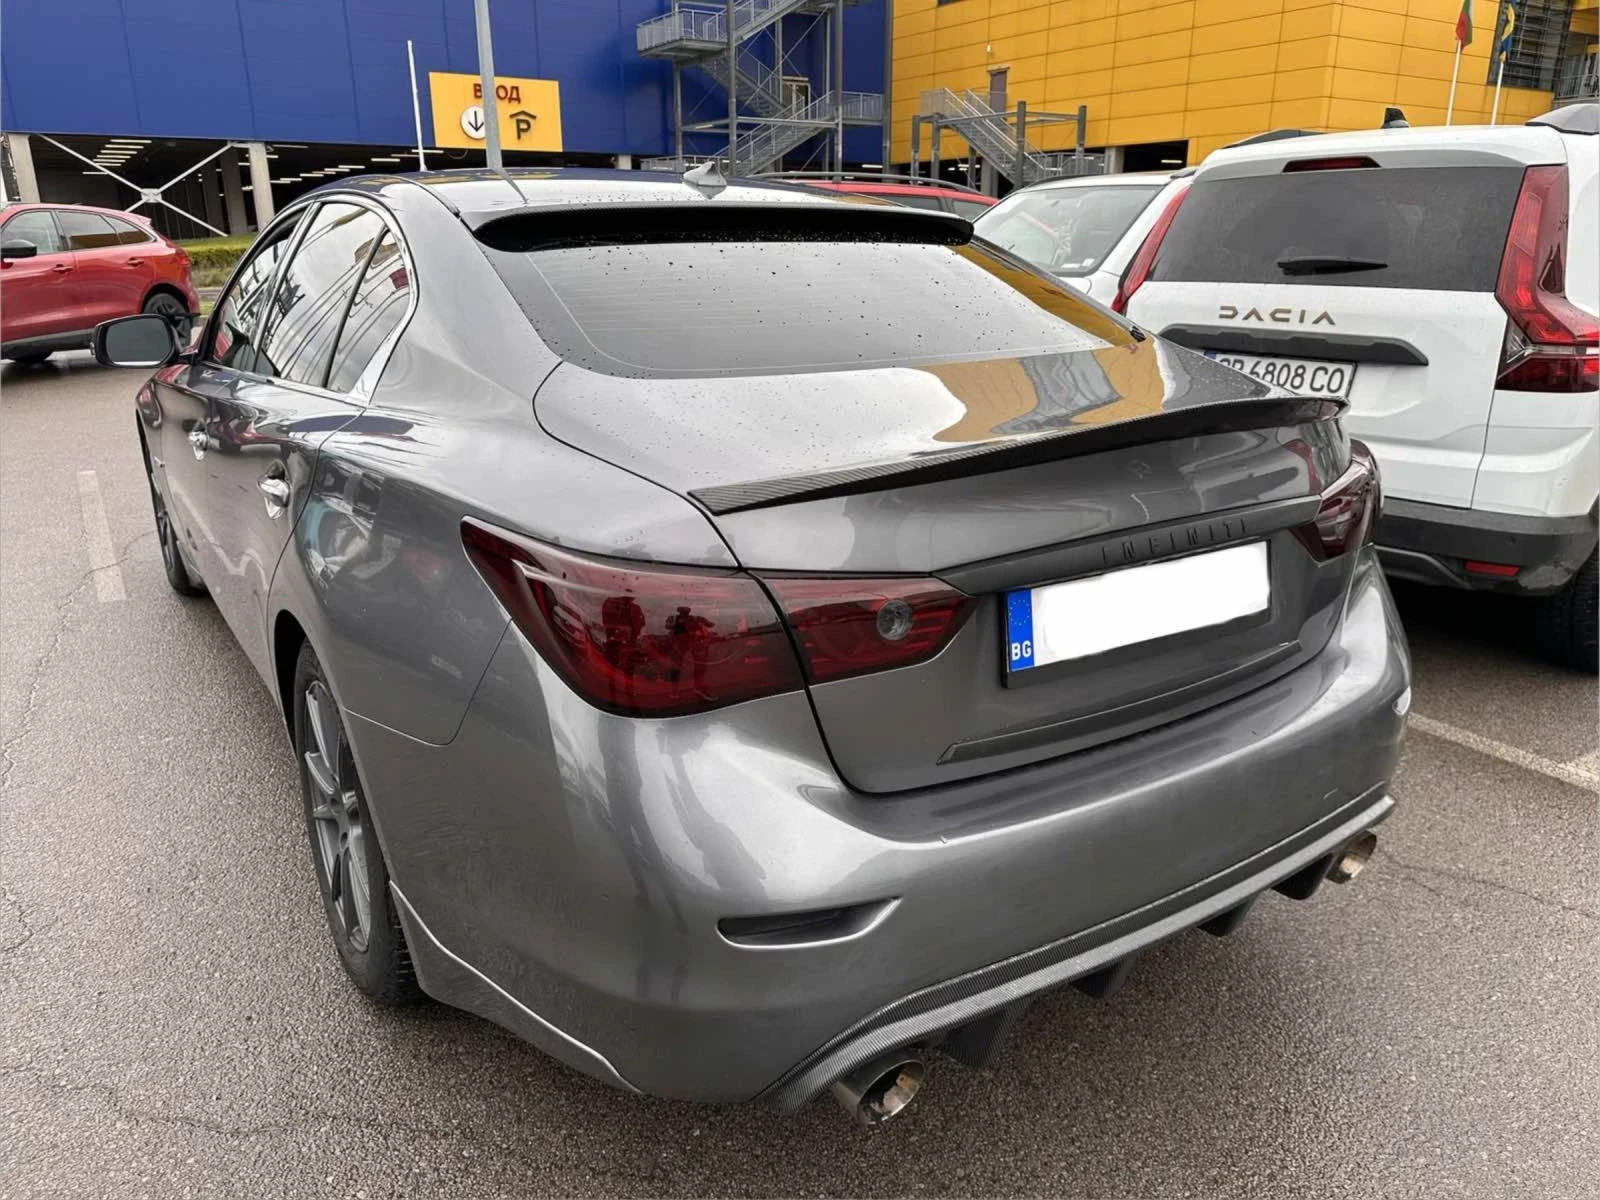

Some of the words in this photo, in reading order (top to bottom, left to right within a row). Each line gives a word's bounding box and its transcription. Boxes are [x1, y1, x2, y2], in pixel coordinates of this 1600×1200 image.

[473, 83, 521, 104] ВОД
[516, 118, 531, 140] P
[1218, 305, 1336, 326] DACIA
[1101, 517, 1248, 565] INFINITI
[1011, 640, 1032, 661] BG
